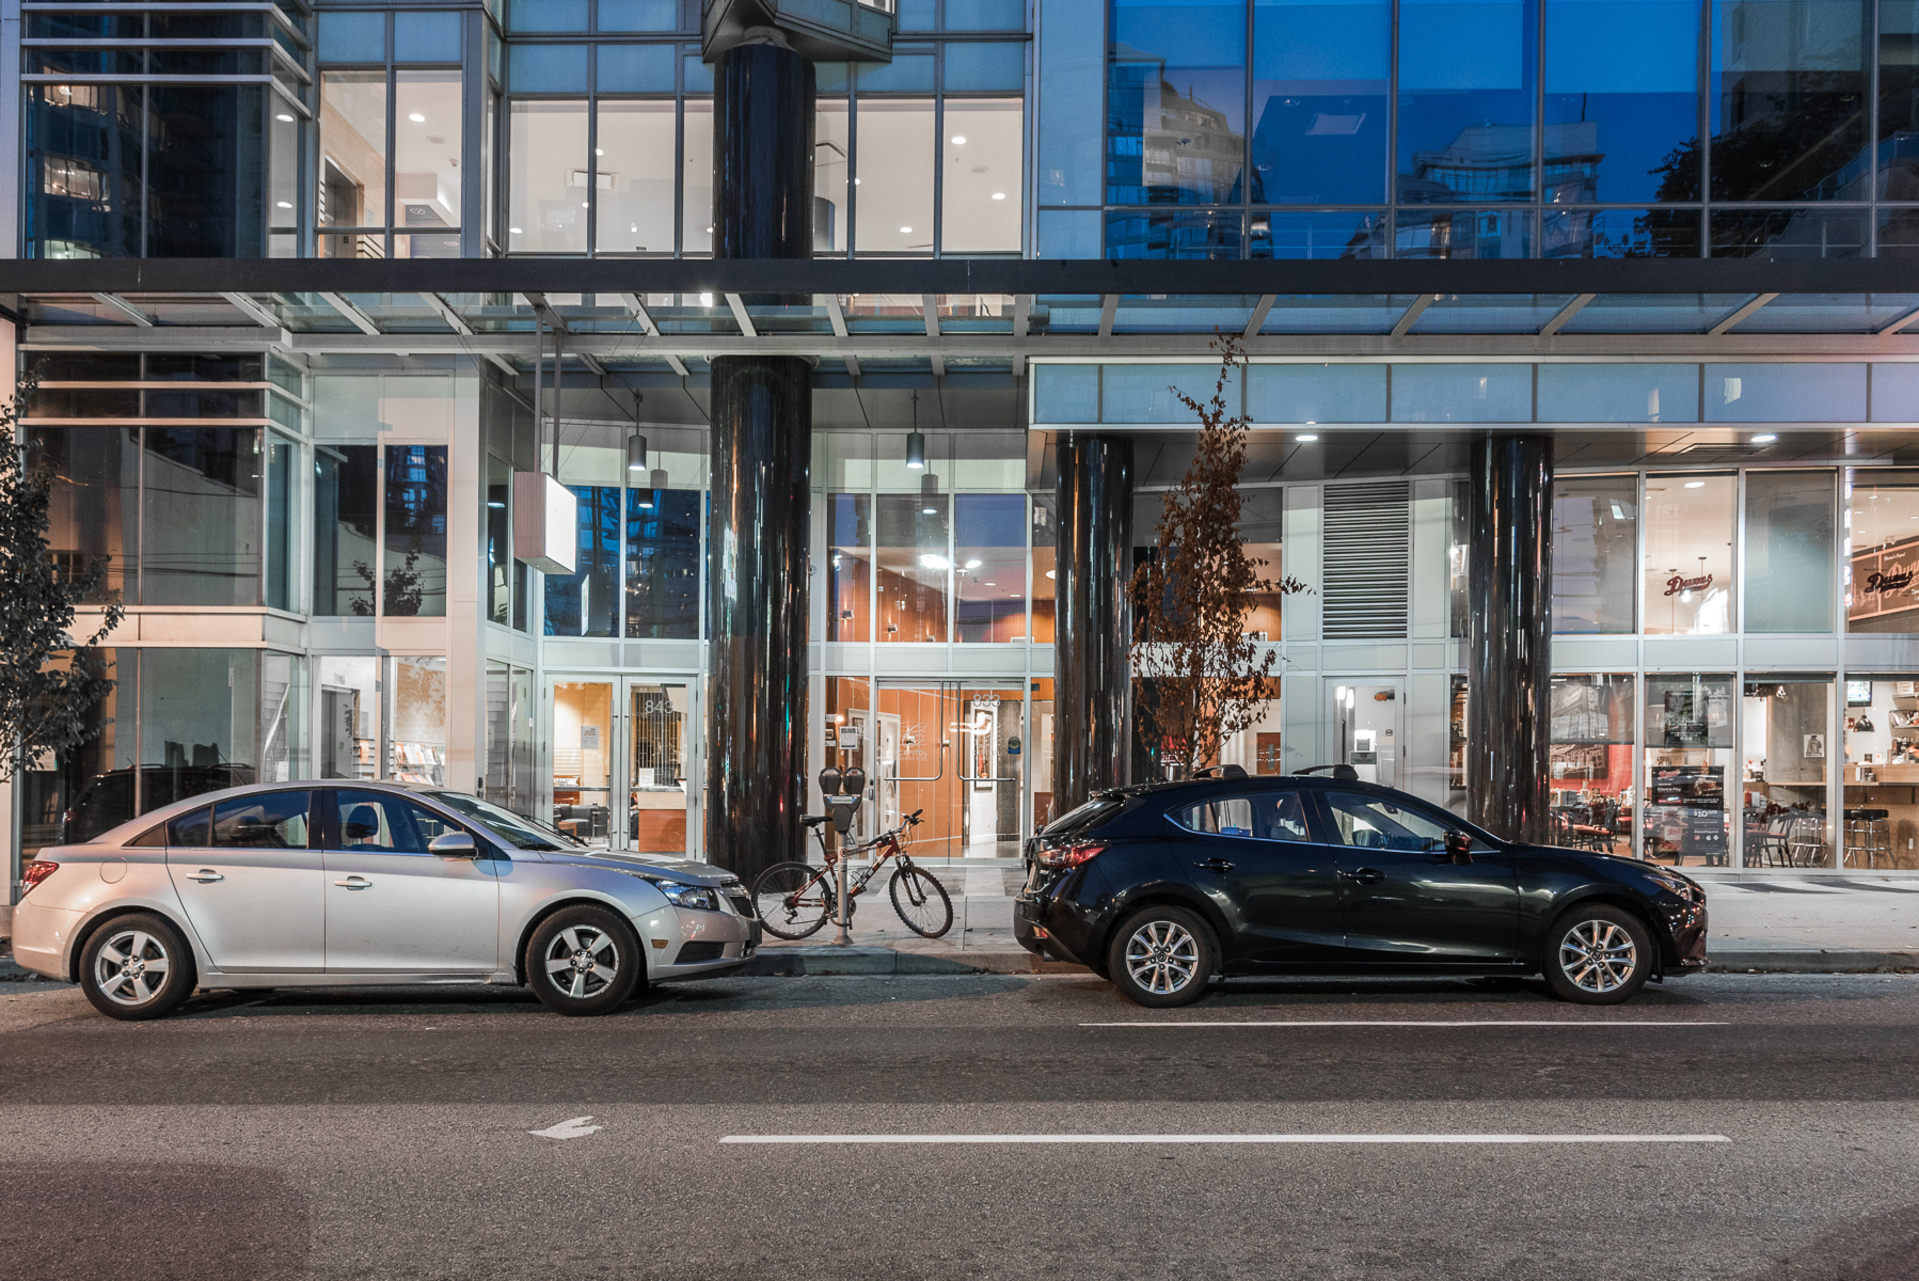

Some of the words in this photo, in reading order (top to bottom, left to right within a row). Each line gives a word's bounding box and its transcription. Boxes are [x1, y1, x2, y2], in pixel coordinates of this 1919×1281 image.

[973, 694, 1001, 707] 833
[645, 700, 674, 714] 843
[899, 749, 928, 757] CAPITOL
[1693, 810, 1708, 818] $10
